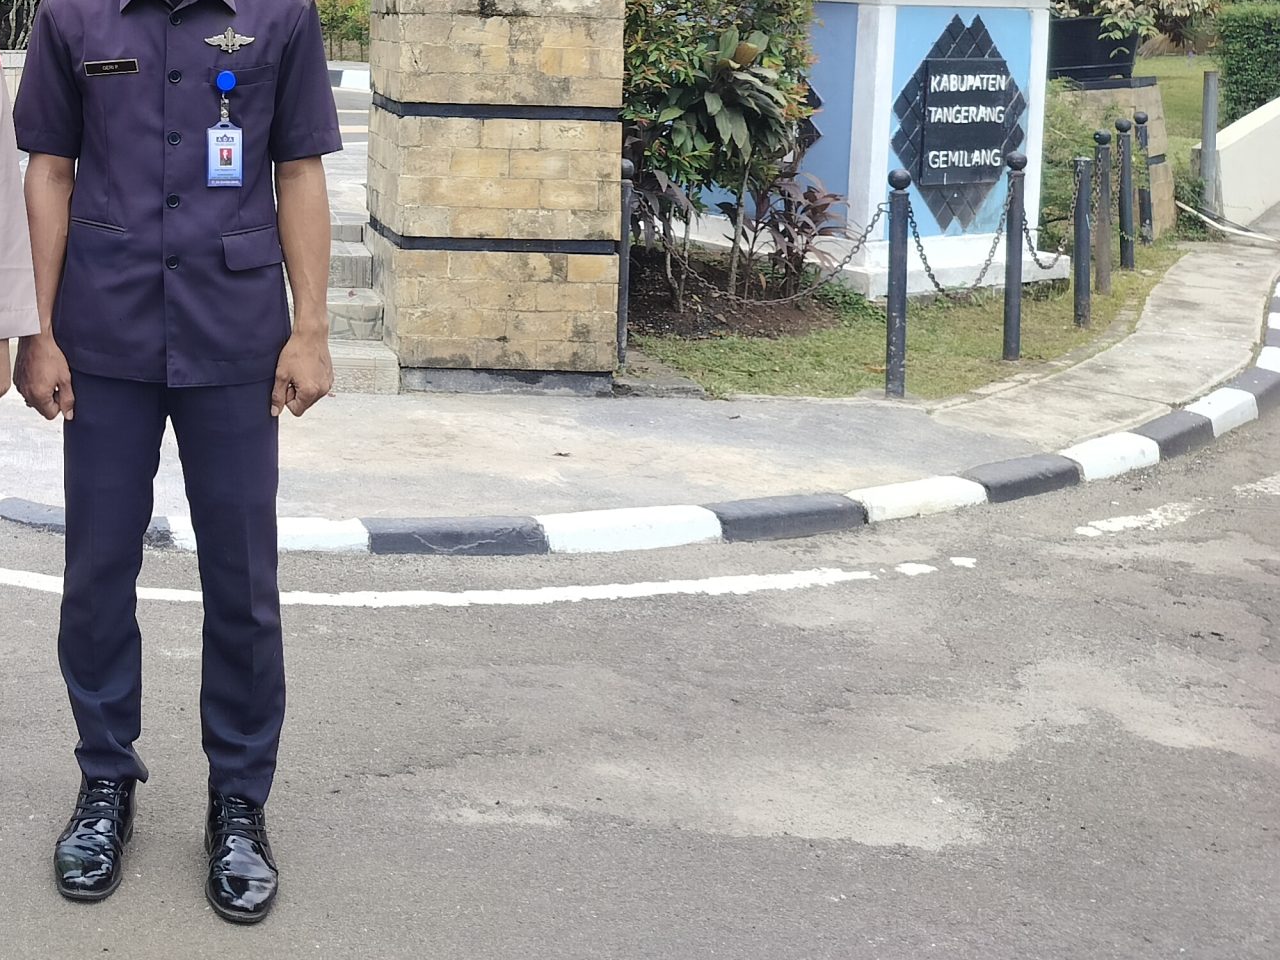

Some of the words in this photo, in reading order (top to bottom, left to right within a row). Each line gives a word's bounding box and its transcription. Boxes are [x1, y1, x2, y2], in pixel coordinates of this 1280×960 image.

[930, 74, 1006, 92] KABUPATEN
[928, 105, 1005, 123] TANGERANG
[928, 149, 1002, 168] GEMILANG
